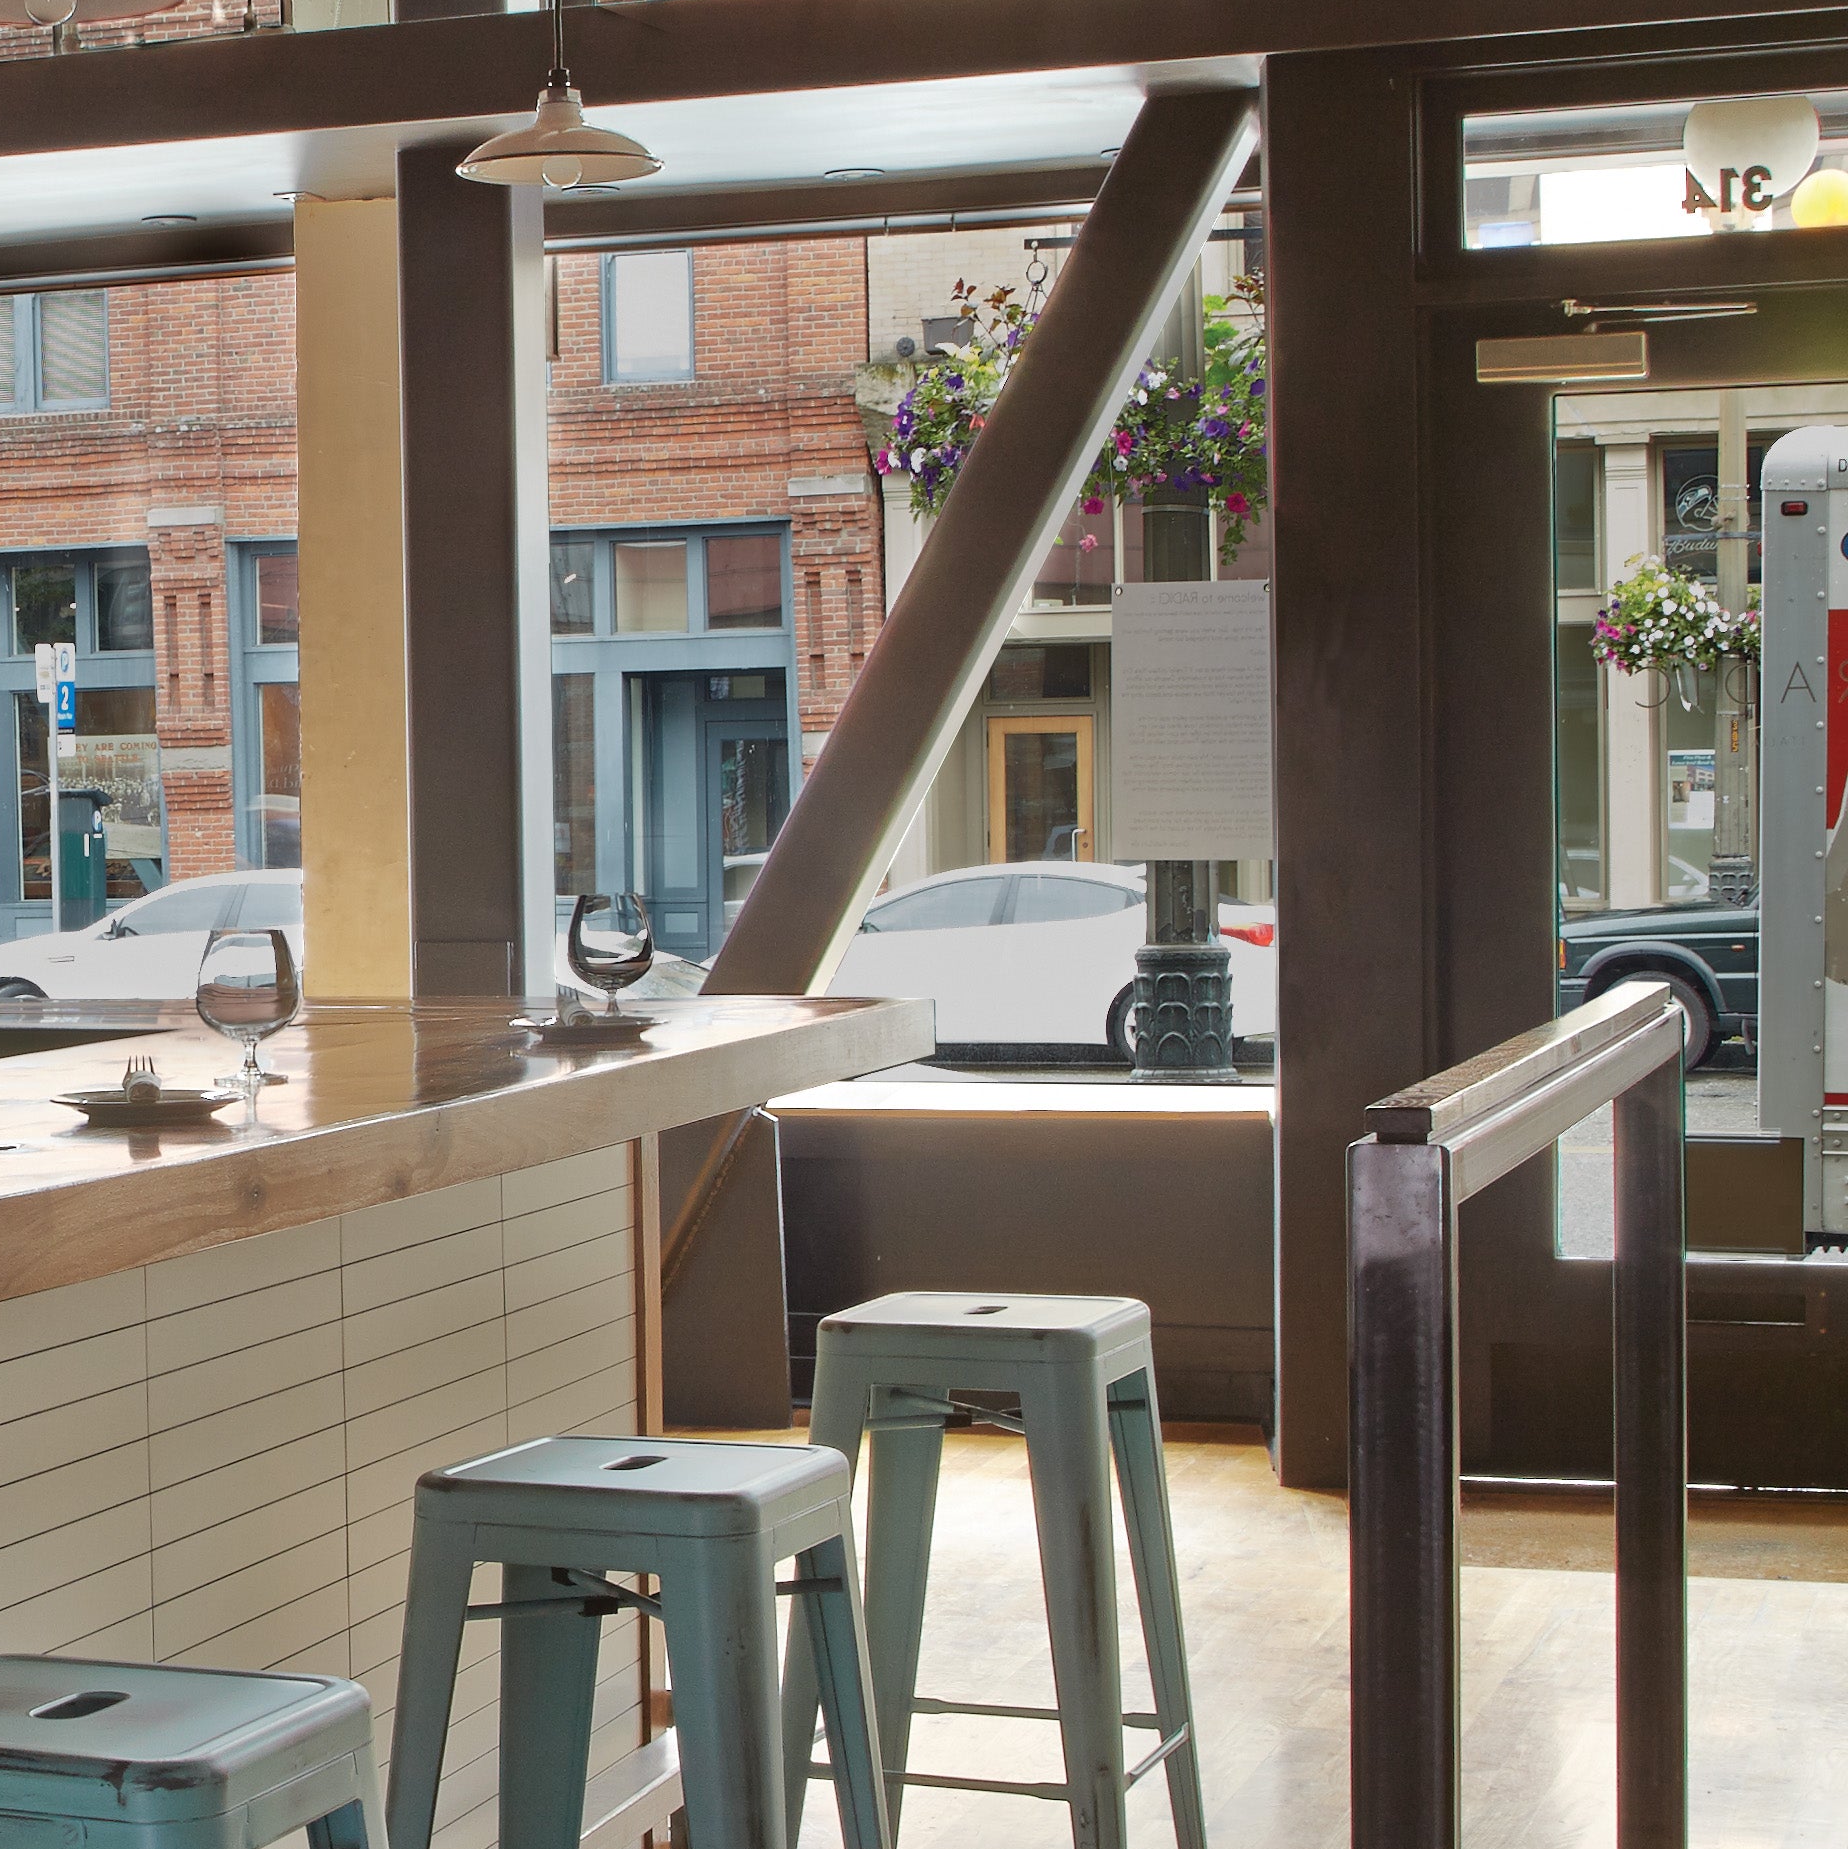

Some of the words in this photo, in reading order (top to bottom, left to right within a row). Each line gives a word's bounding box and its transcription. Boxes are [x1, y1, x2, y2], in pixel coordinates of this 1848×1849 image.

[61, 685, 69, 711] 2
[94, 742, 114, 751] ARE
[120, 741, 157, 751] COMING
